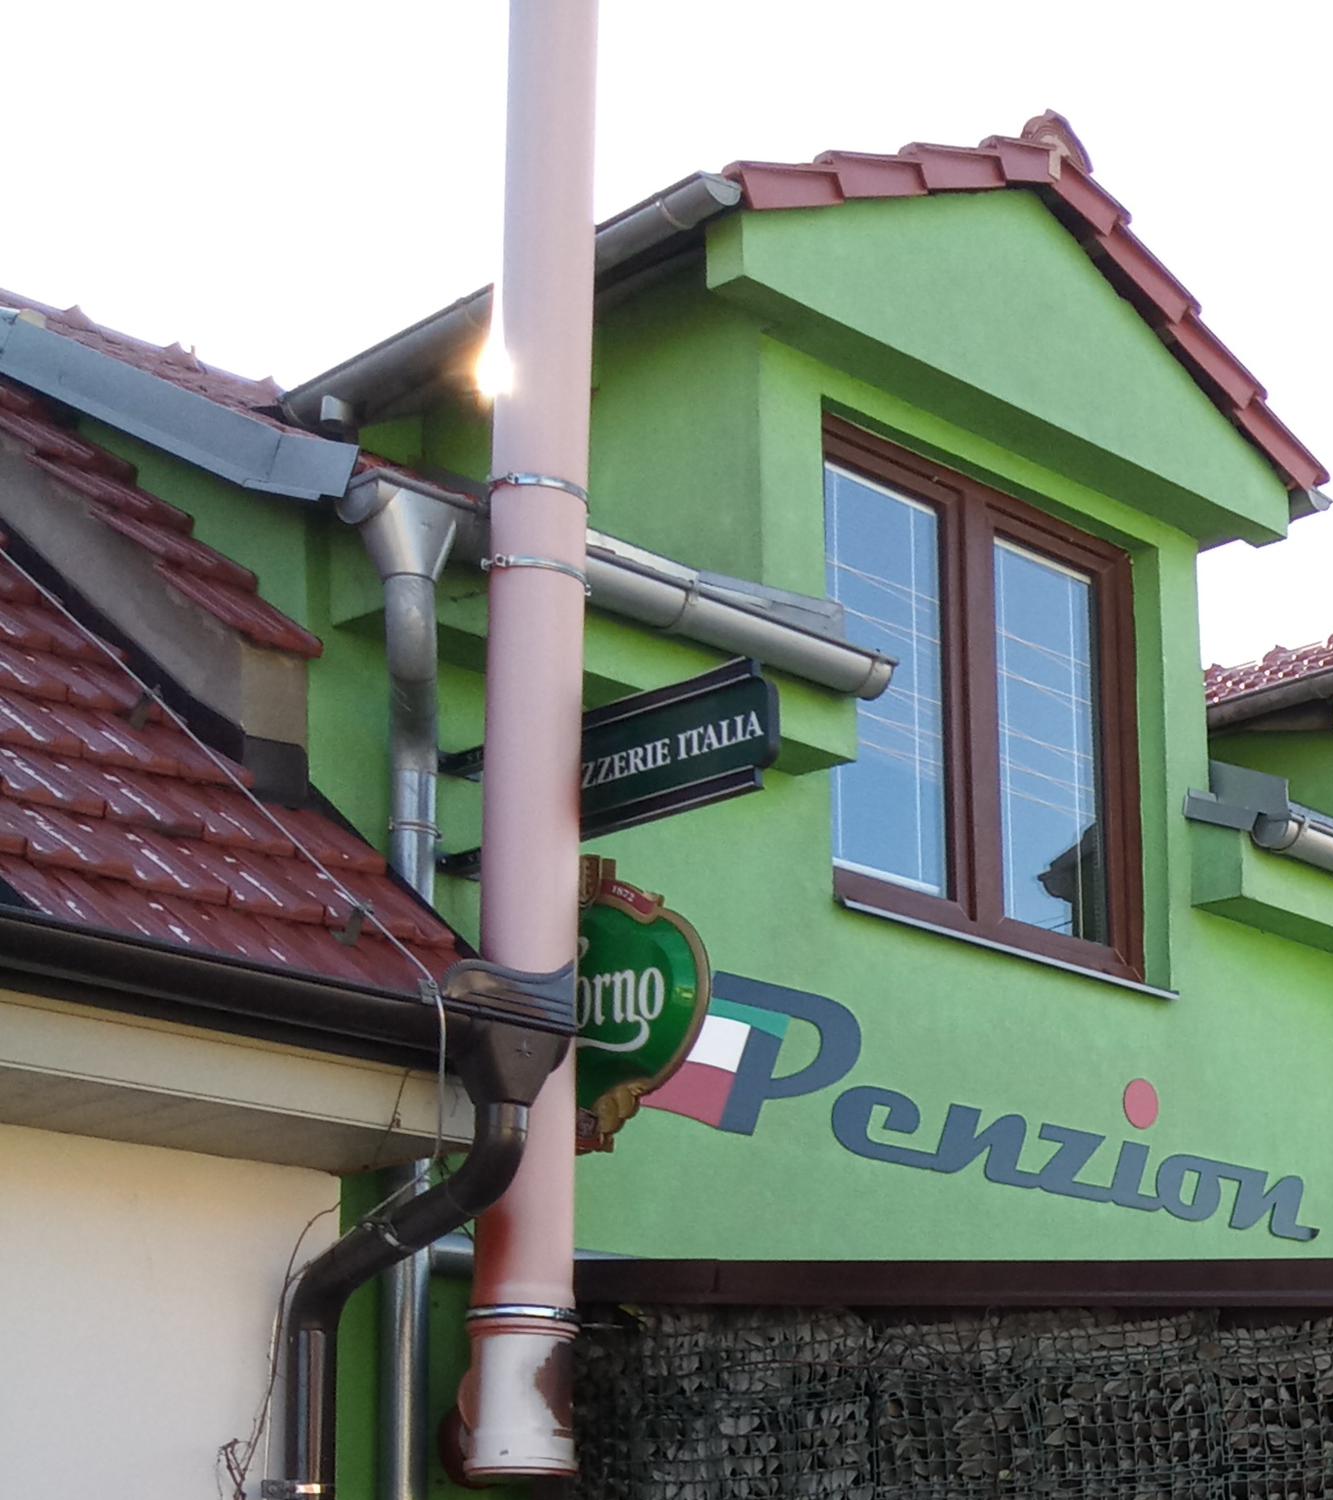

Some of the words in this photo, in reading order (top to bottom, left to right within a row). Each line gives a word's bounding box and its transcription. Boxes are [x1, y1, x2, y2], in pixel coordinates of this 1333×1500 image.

[677, 710, 764, 761] ITALIA
[611, 885, 636, 903] 1872
[711, 970, 1320, 1242] Penzion
